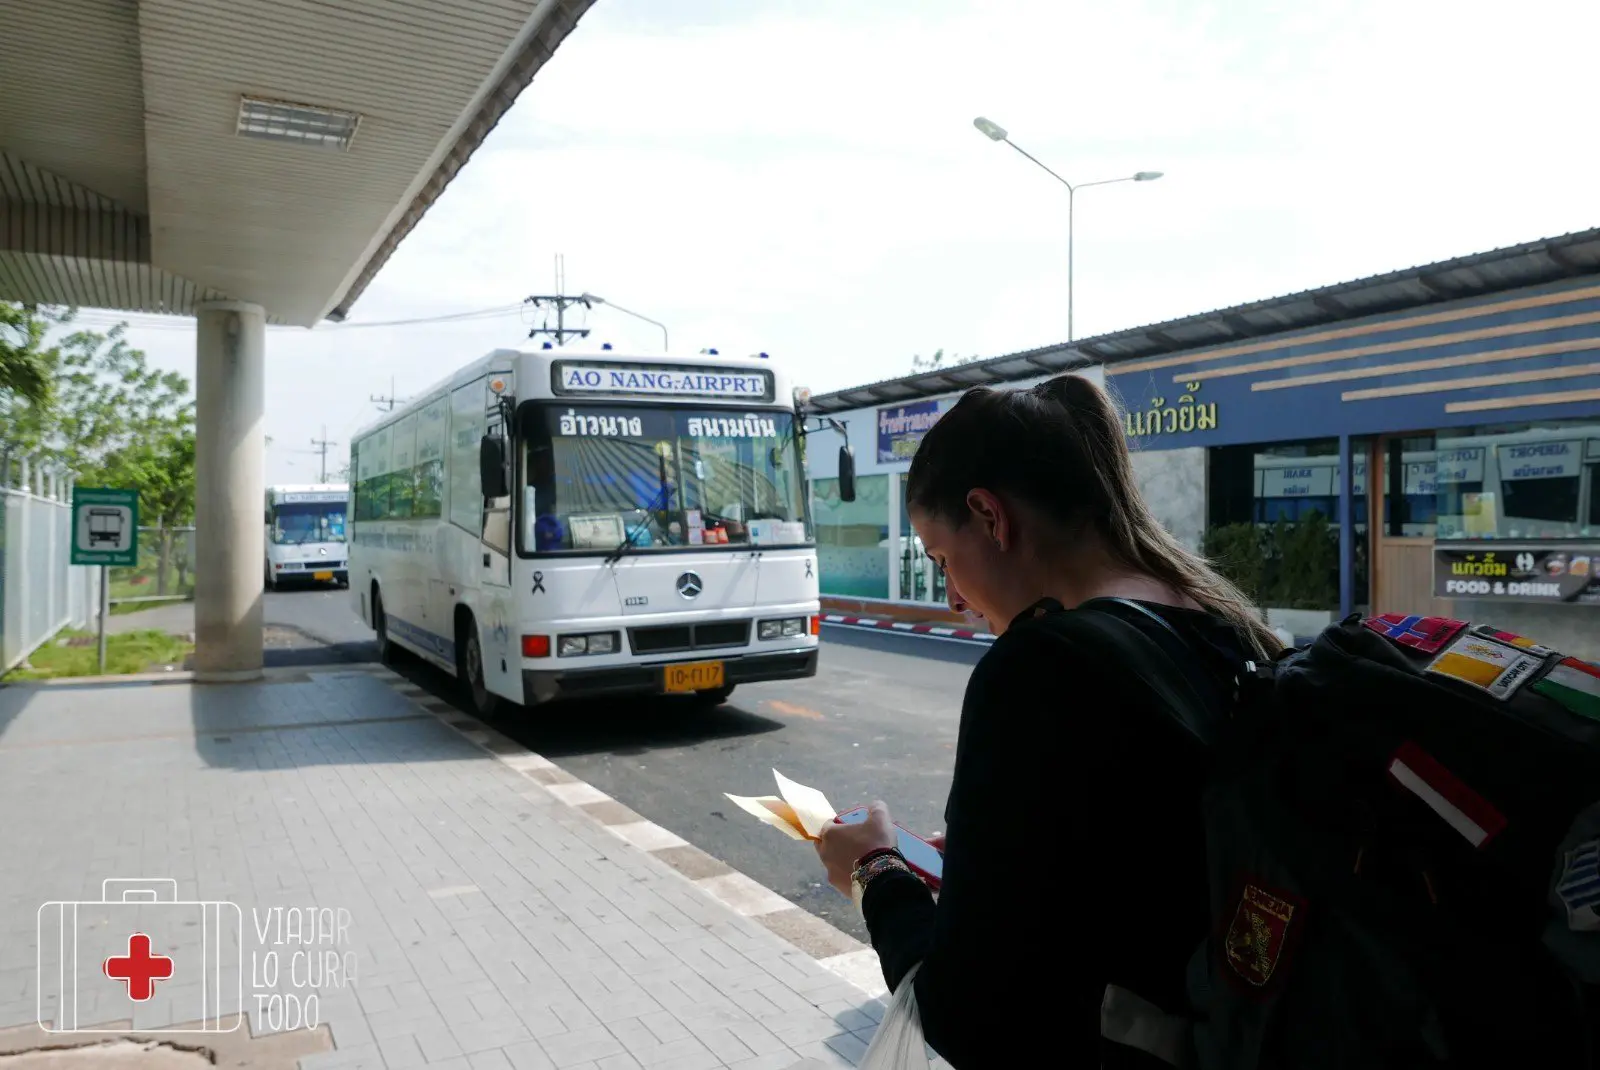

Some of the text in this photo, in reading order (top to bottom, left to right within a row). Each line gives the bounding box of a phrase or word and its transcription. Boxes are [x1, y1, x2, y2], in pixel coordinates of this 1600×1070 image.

[568, 370, 601, 386] AO
[1126, 381, 1217, 437] แก้วยิ้ม
[560, 408, 777, 438] อ่าวนาง สนามบิน
[1446, 580, 1561, 597] FOOD & DRINK
